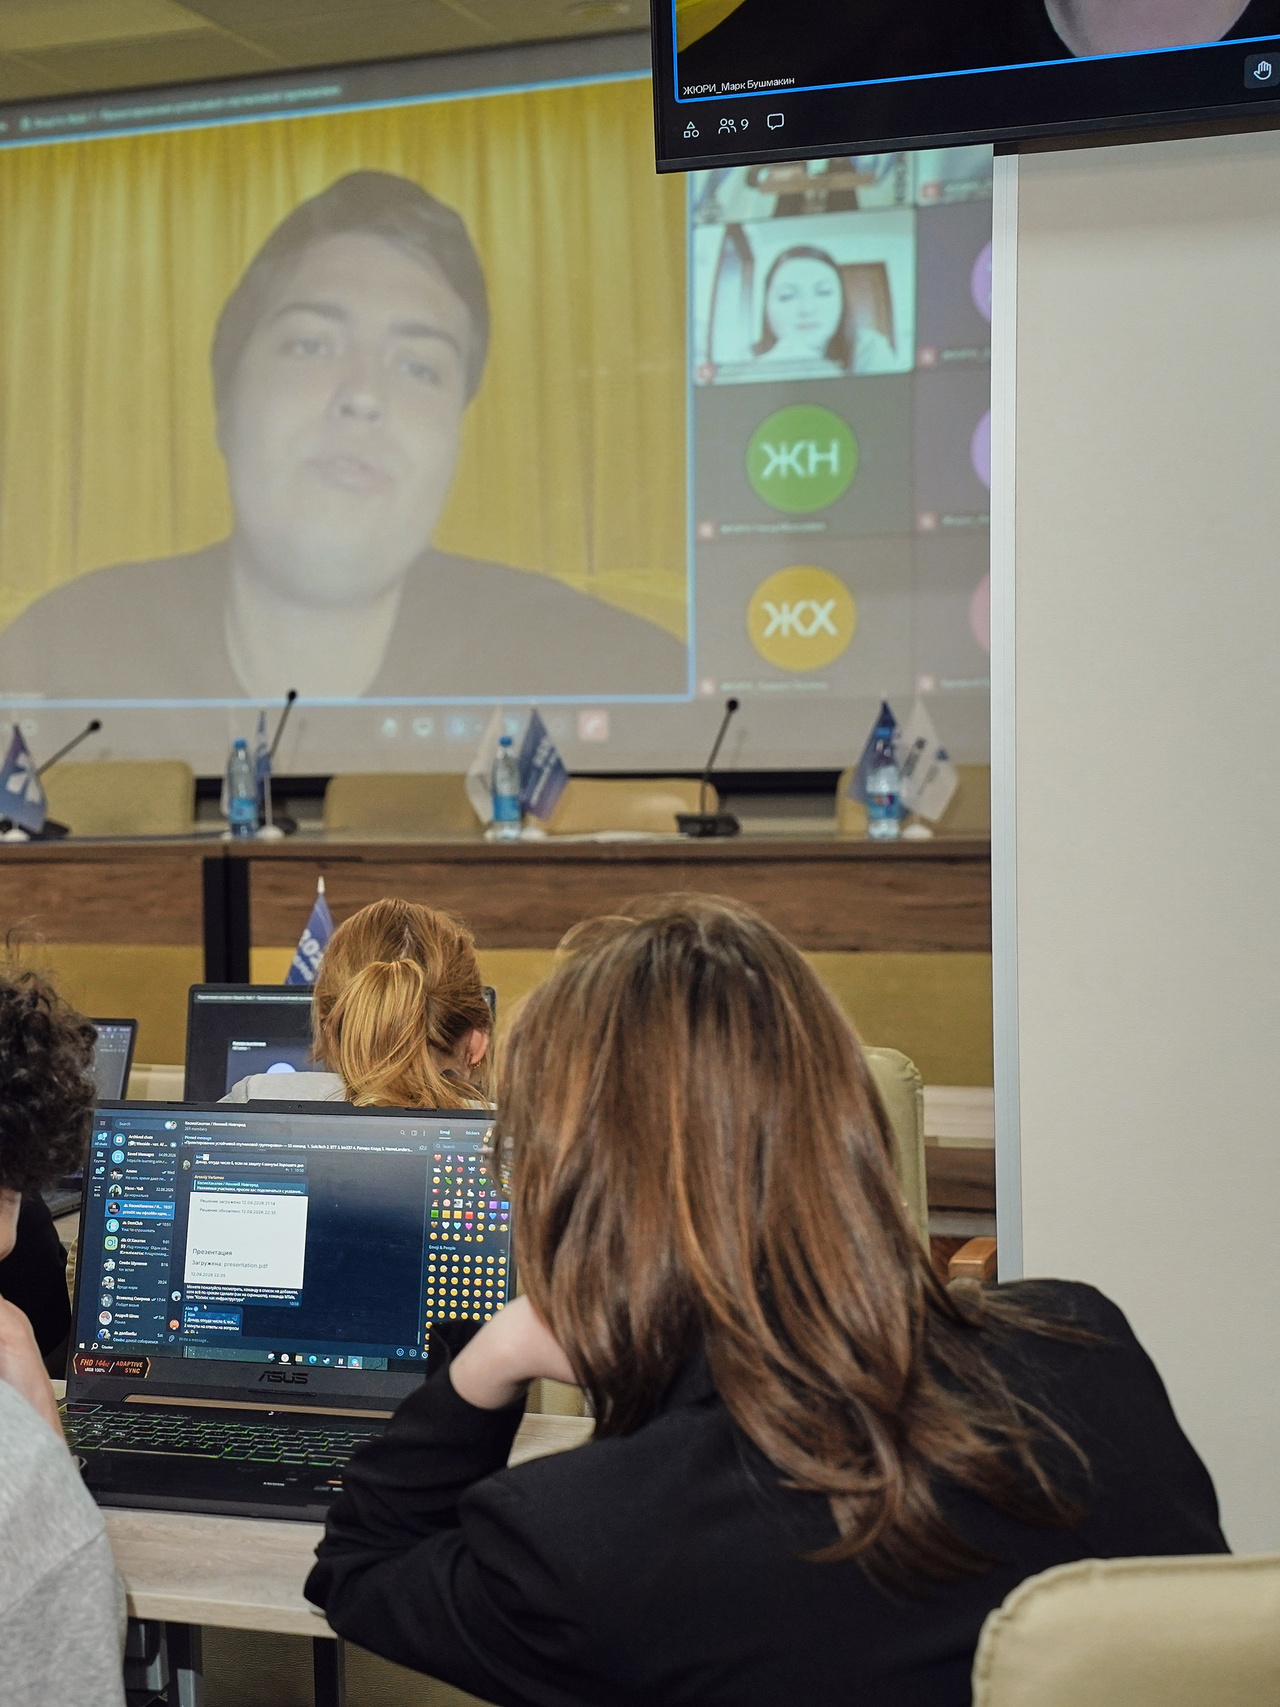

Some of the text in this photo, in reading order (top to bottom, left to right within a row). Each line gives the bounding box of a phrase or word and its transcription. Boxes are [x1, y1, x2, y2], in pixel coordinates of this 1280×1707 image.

[683, 77, 794, 95] ЖЮРИ_Марк Бушмакин
[740, 119, 748, 131] 9
[761, 440, 839, 478] ЖН
[762, 599, 838, 638] ЖХ
[193, 1248, 232, 1257] Презентация
[80, 1358, 93, 1366] FHD
[116, 1360, 143, 1368] ADAPTIVE
[258, 1370, 308, 1385] ASUS
